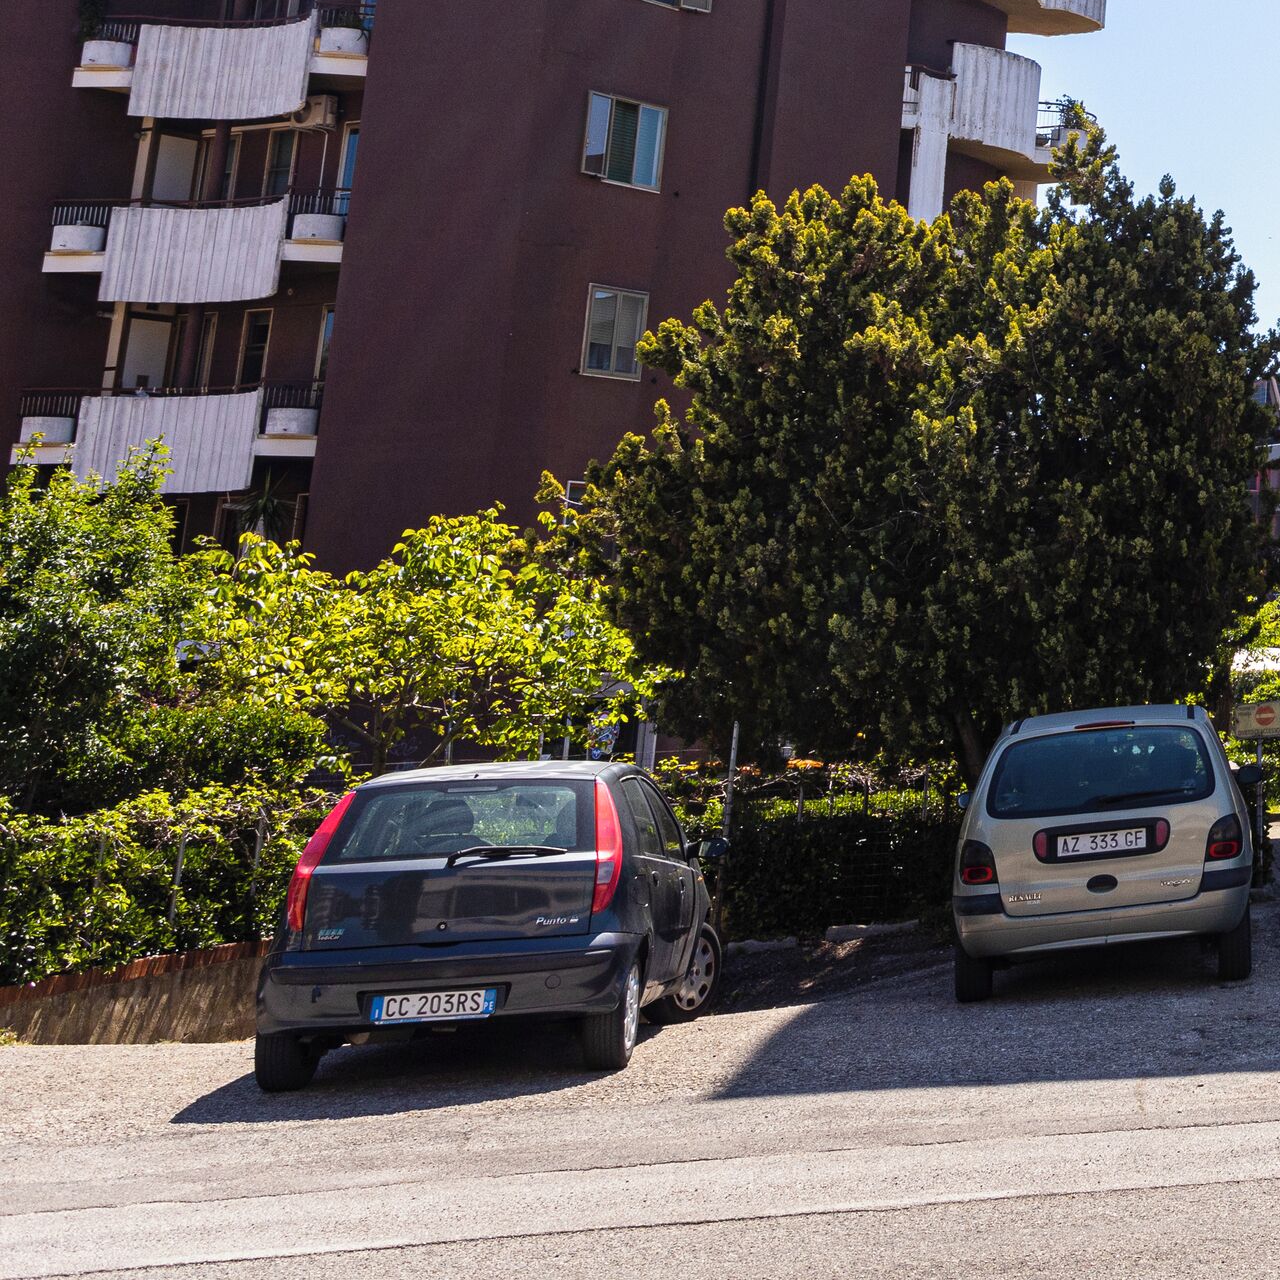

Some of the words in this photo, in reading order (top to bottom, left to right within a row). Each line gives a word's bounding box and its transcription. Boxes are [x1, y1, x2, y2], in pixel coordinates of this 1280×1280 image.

[1090, 833, 1119, 851] 333
[1008, 893, 1042, 903] RENAULT
[535, 916, 567, 926] Punto
[416, 992, 482, 1015] 203RS
